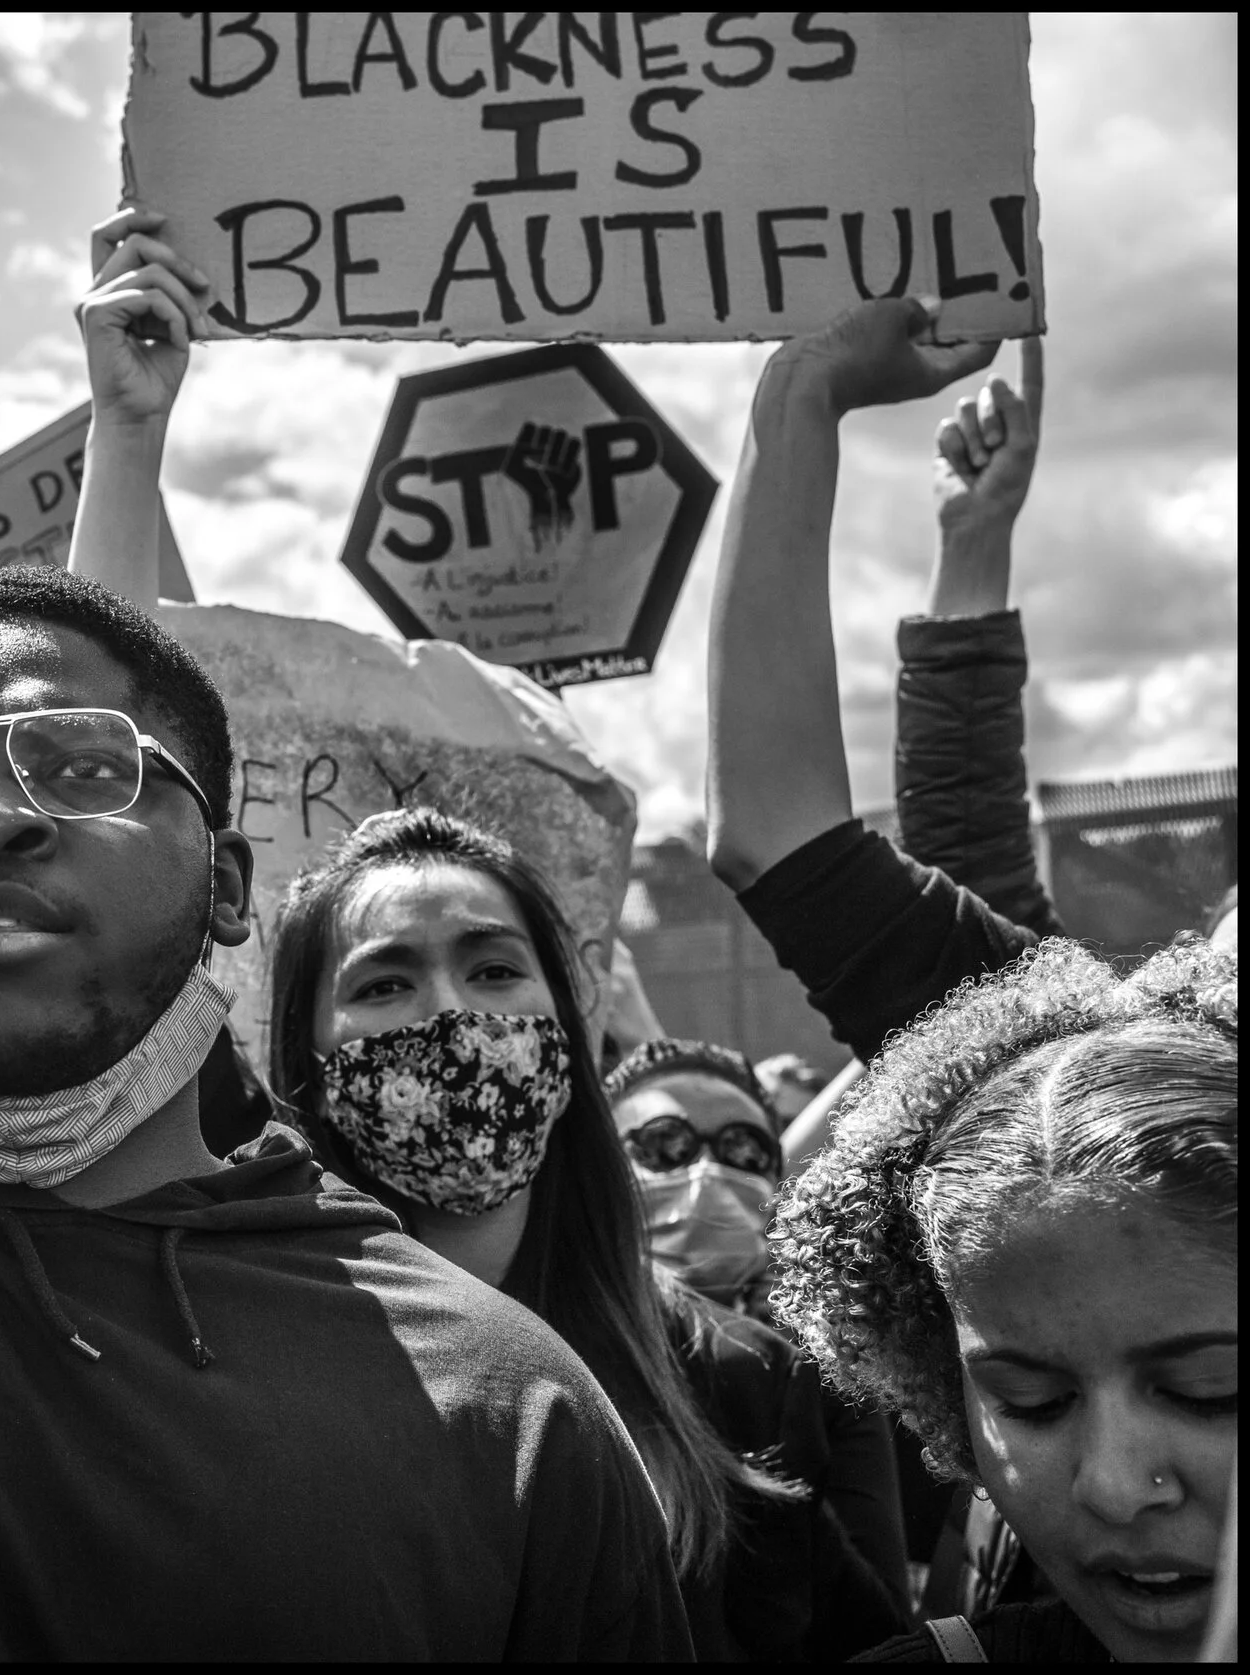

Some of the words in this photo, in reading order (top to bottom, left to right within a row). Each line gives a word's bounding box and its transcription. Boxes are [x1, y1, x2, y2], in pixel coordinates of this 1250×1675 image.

[188, 12, 858, 98] BLACKNESS
[473, 87, 705, 196] IS
[207, 195, 1030, 334] BEAUTIFUL!
